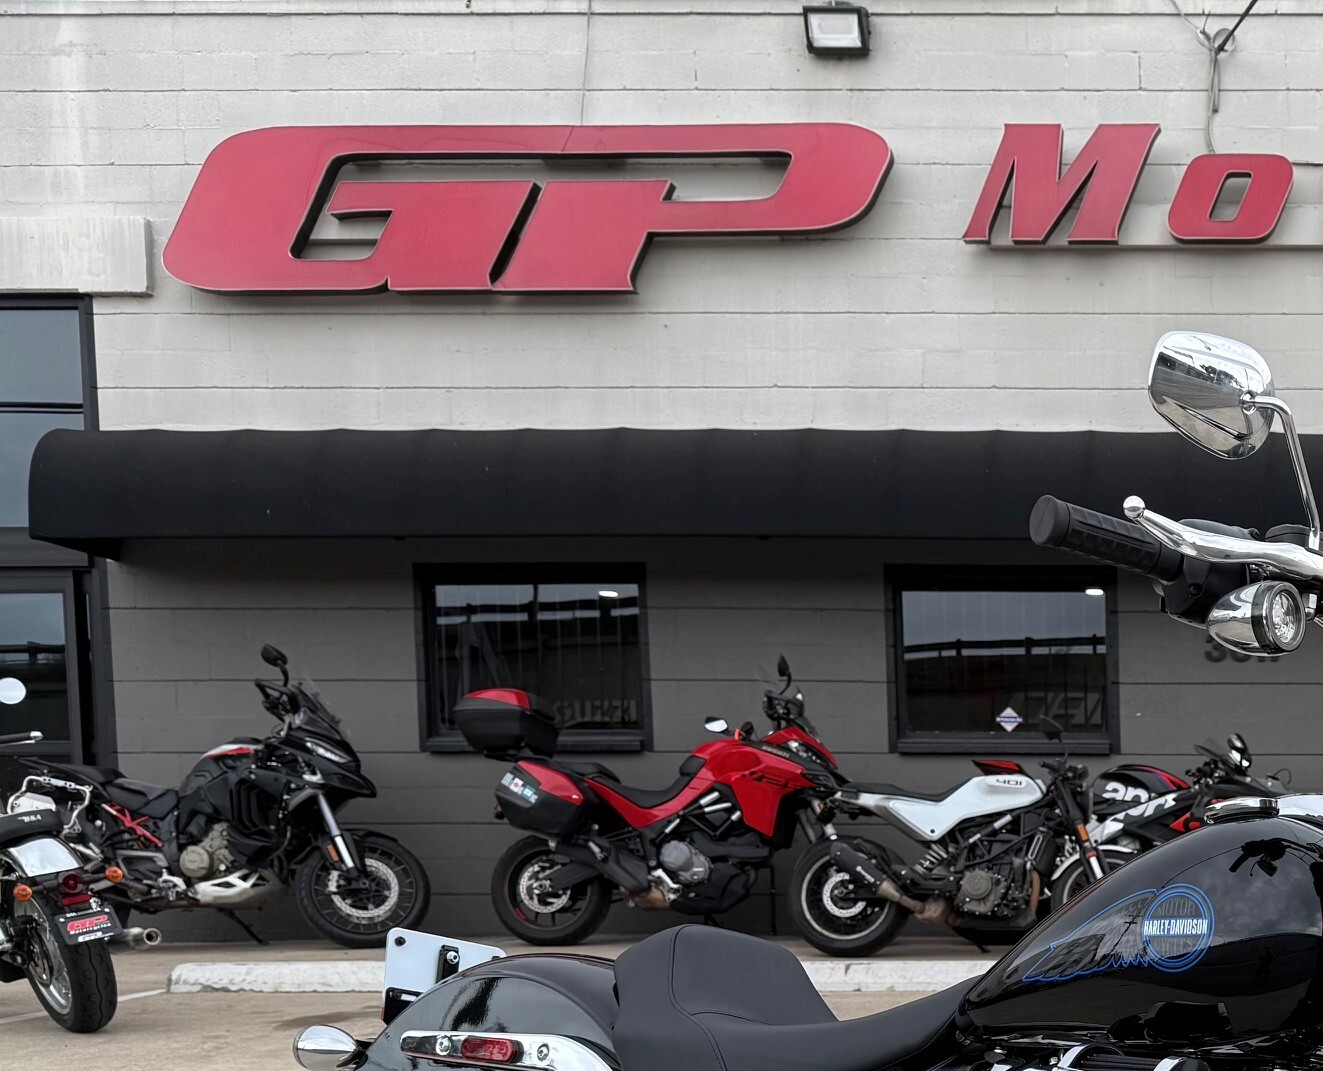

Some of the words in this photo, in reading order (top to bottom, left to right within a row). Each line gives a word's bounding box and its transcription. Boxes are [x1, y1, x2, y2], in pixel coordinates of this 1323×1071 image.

[161, 122, 893, 296] GP
[1155, 897, 1197, 917] MOTOR
[1143, 918, 1209, 936] HARLEY-DAVIDSON
